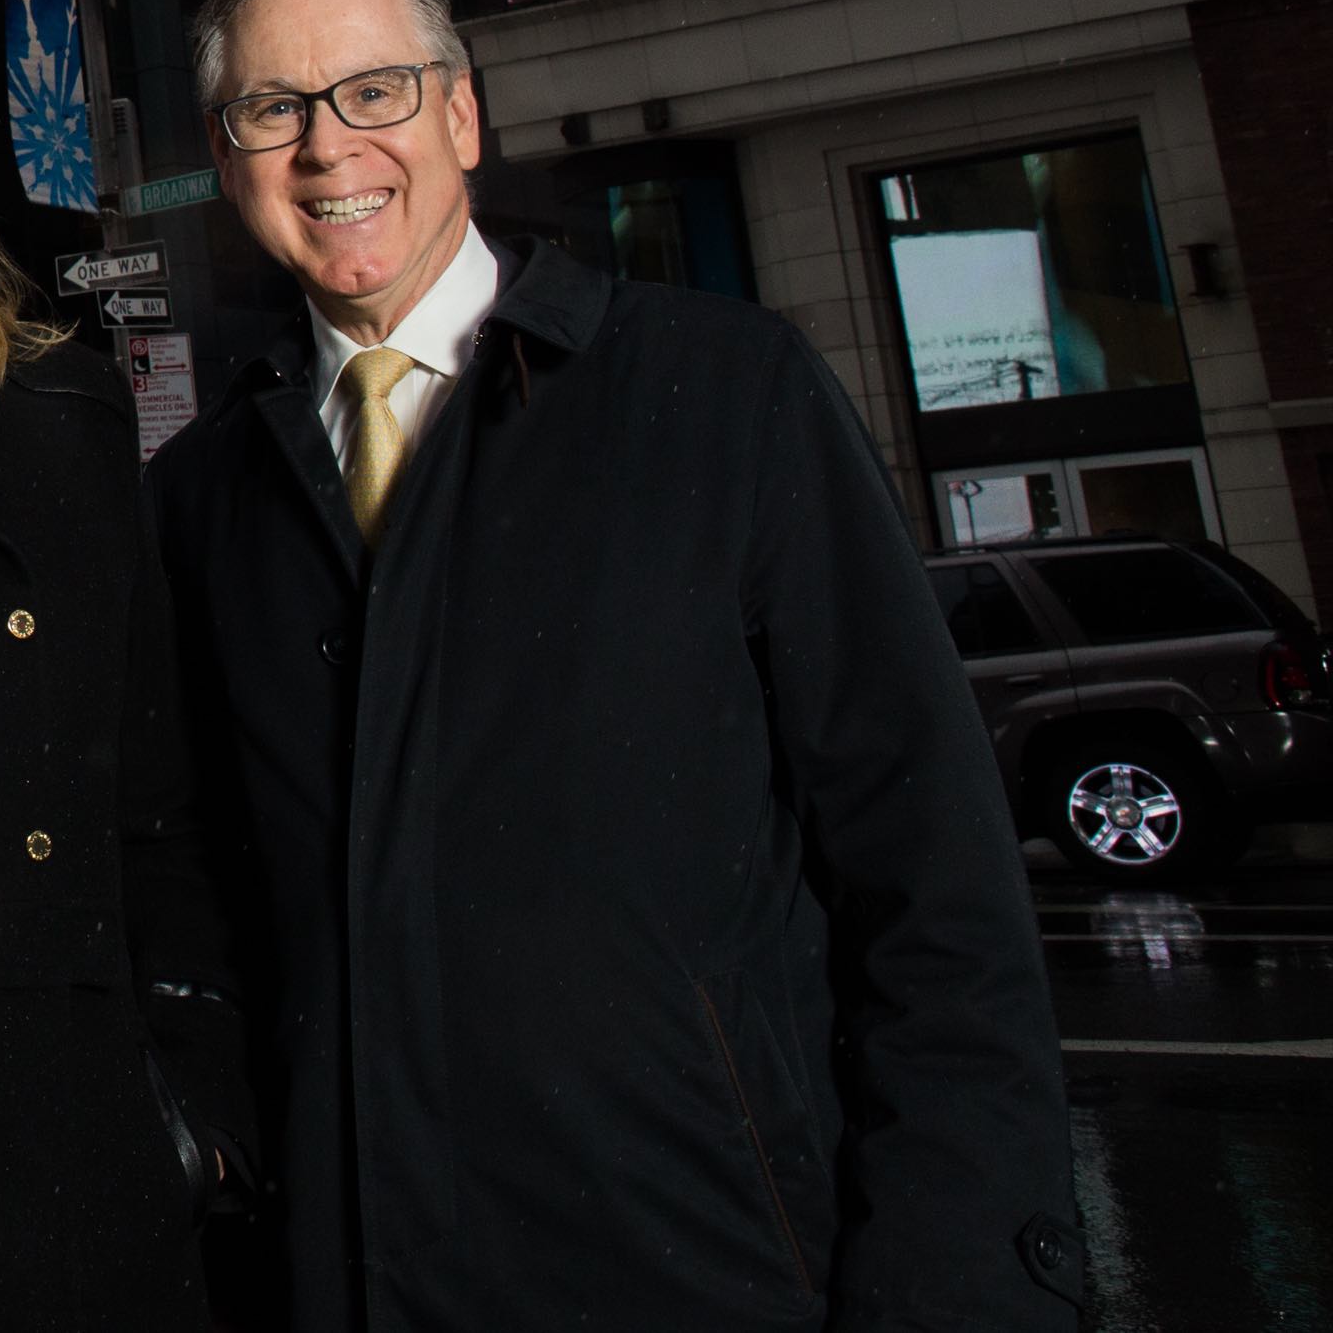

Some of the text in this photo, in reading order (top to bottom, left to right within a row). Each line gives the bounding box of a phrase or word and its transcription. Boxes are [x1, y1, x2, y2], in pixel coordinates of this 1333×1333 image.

[143, 173, 214, 210] BROADWAY
[77, 255, 150, 280] ONE WAY
[111, 299, 163, 315] ONE WAY
[136, 393, 184, 404] COMMERCIAL
[138, 402, 193, 413] VEHICLES ONLY
